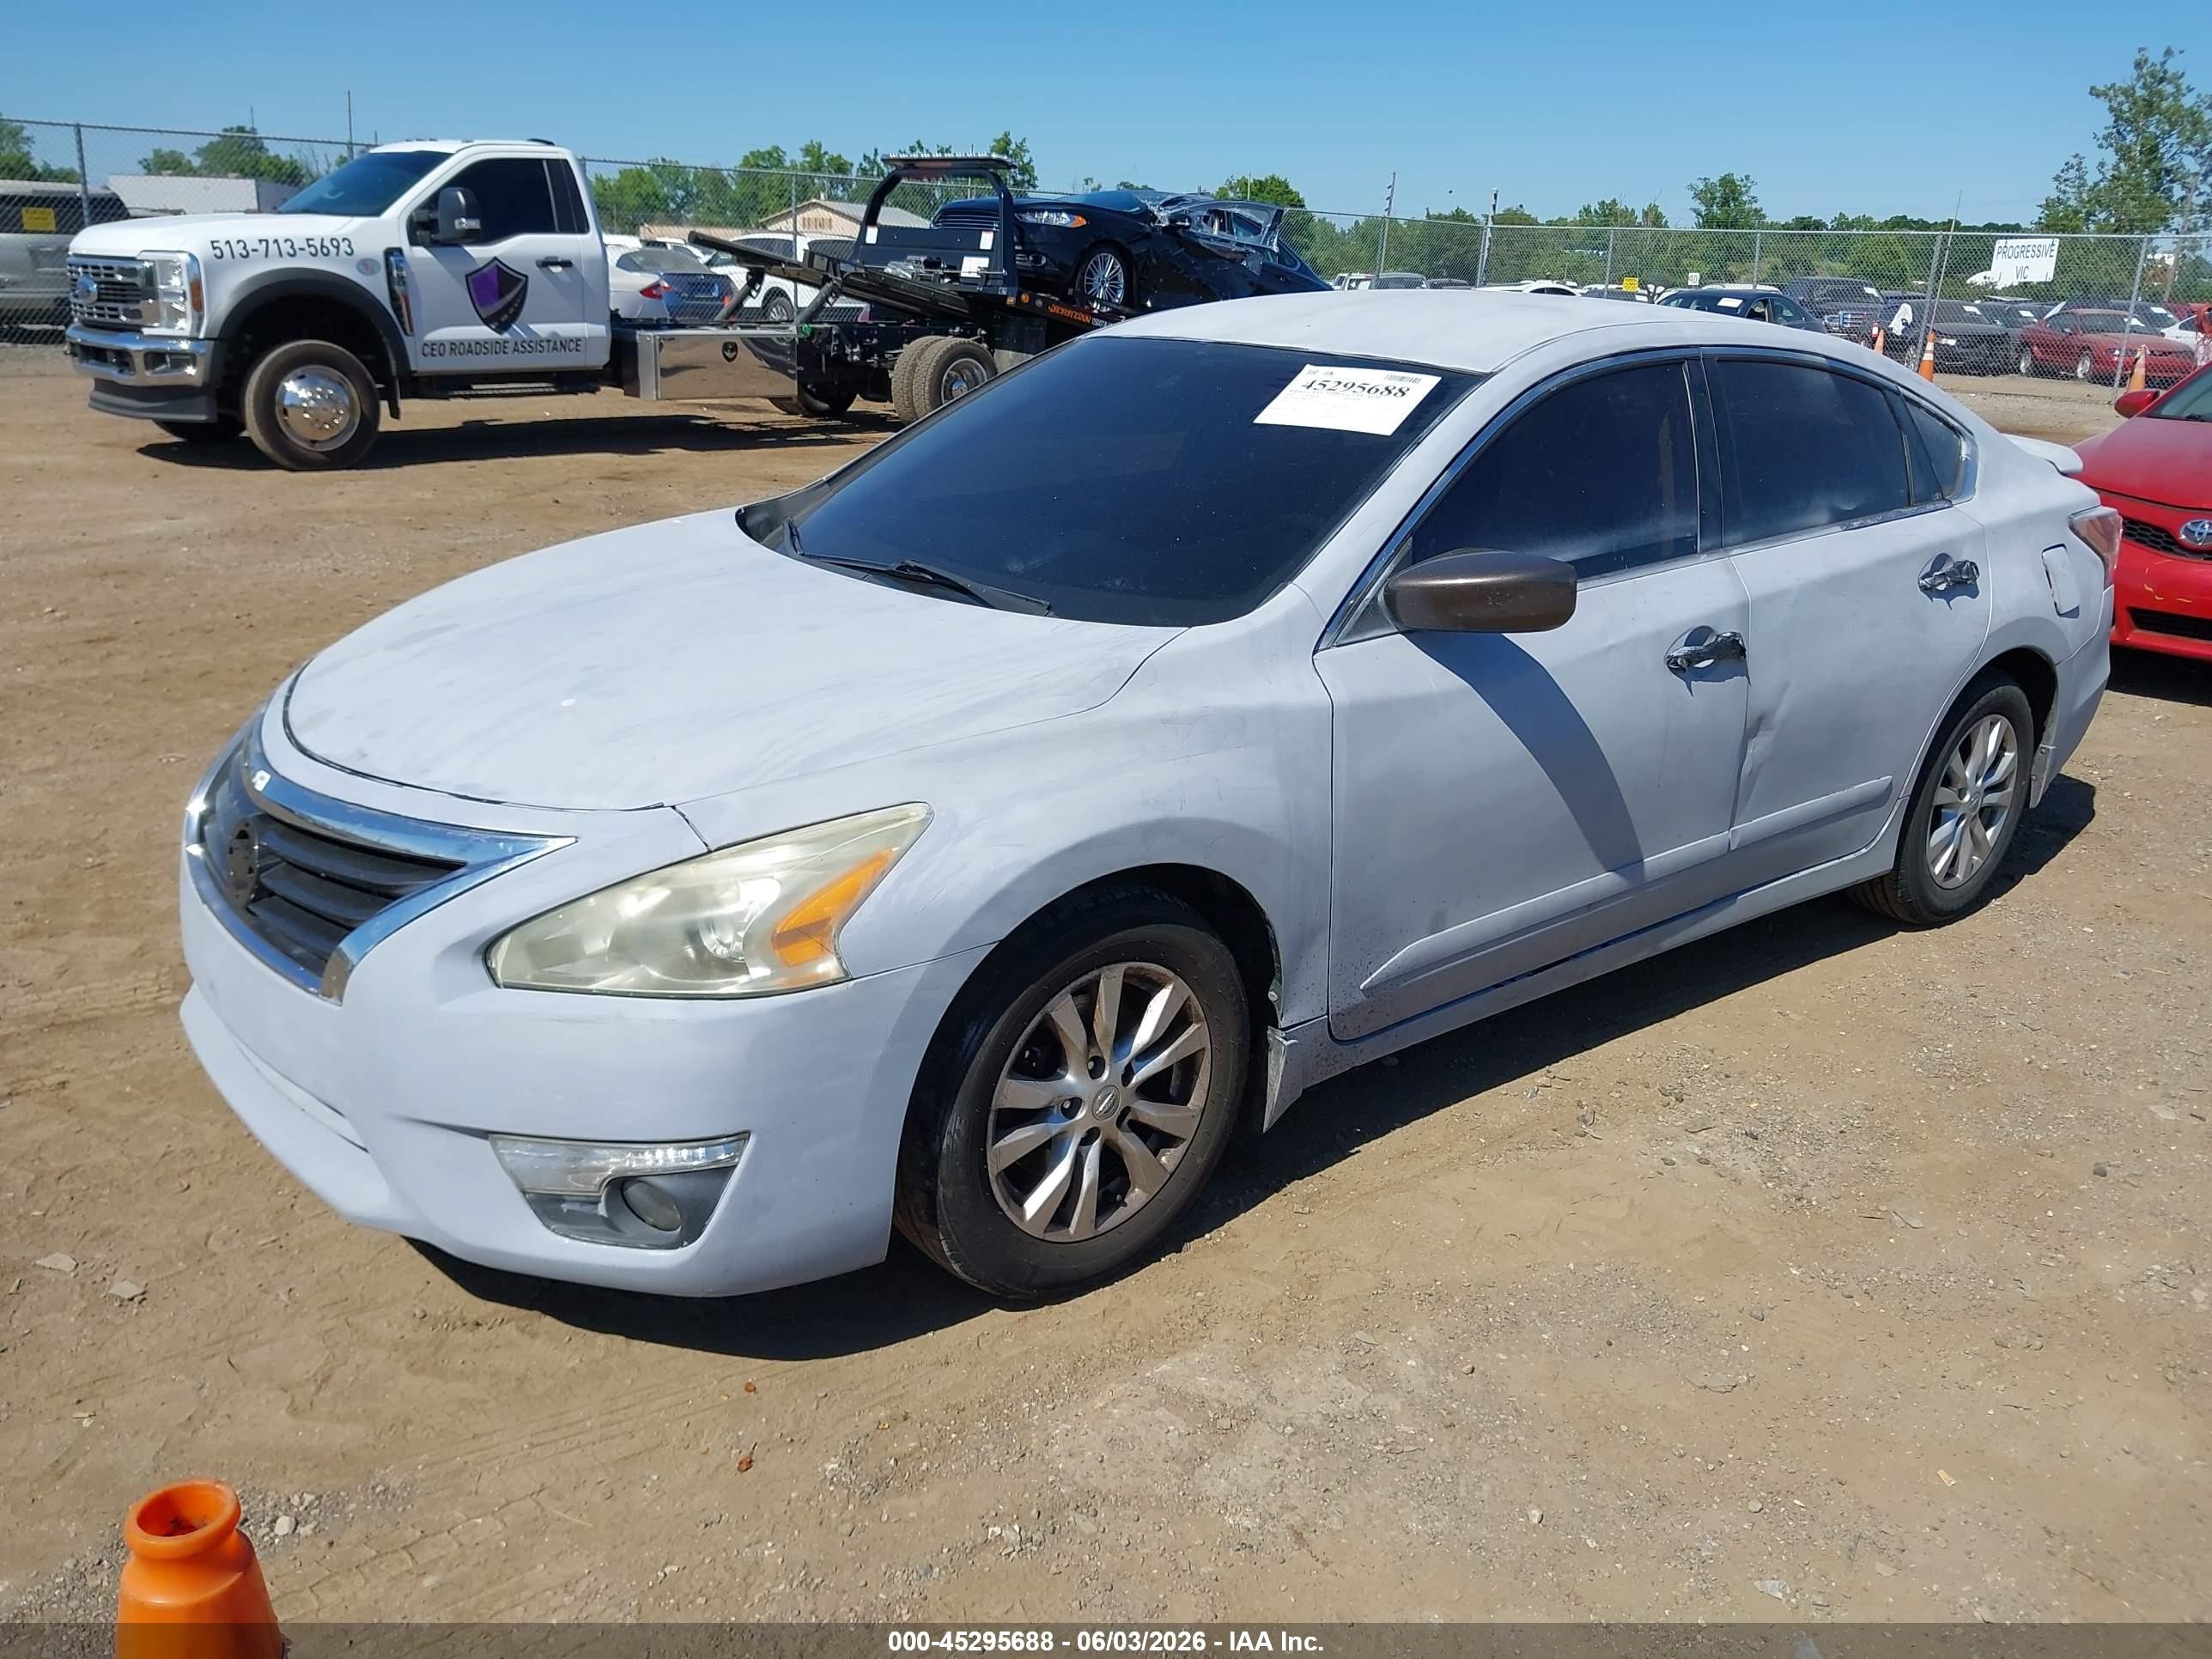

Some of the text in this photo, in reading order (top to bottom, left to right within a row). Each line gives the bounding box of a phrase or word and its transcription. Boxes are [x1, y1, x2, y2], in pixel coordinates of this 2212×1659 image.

[210, 237, 355, 259] 513-713-5693
[1996, 243, 2056, 259] PROGRESSIVE
[2015, 265, 2029, 280] VIC
[421, 338, 582, 358] CEO ROADSIDE ASSISTANCE
[1301, 379, 1411, 398] 45295688
